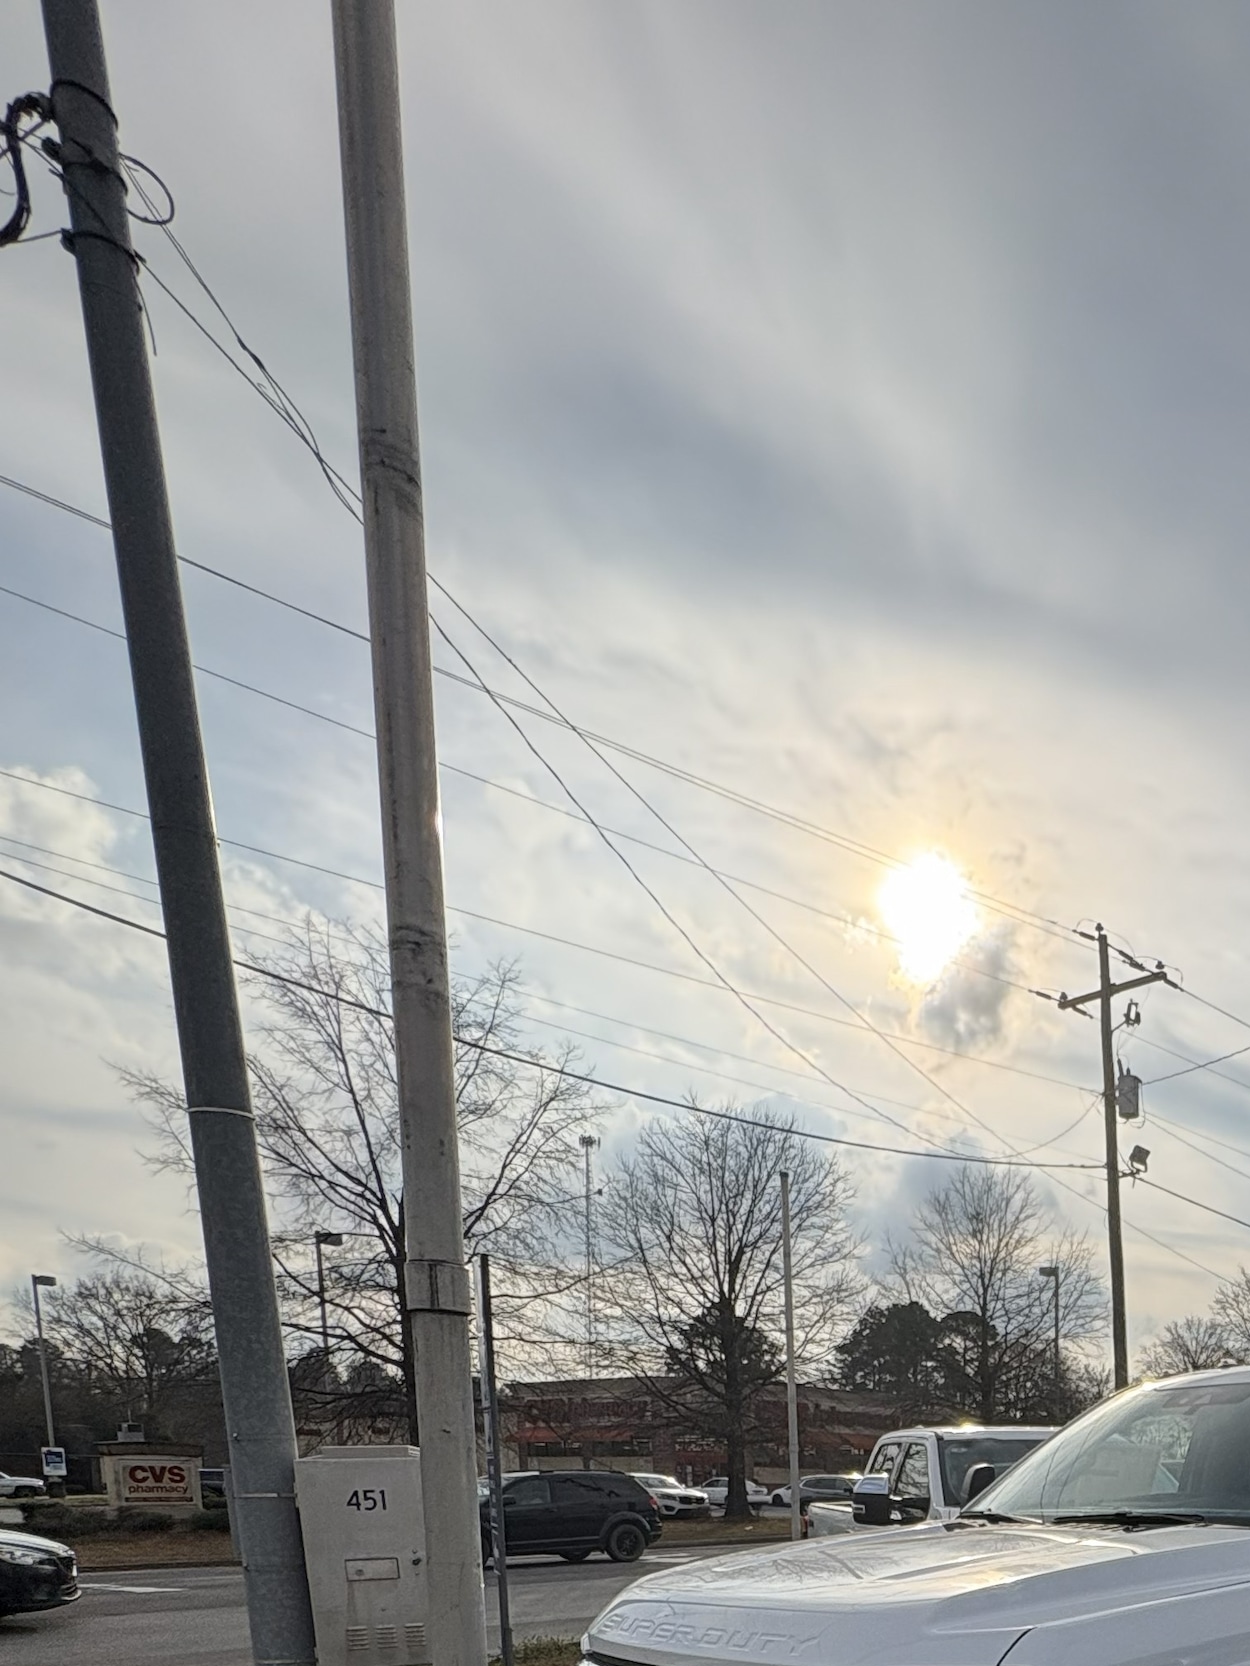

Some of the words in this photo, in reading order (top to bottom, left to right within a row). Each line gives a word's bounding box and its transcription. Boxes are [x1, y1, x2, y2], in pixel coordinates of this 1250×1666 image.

[129, 1465, 186, 1484] CVS
[128, 1485, 188, 1495] pharmacy
[346, 1489, 387, 1511] 451
[602, 1613, 696, 1645] SUPER
[698, 1626, 820, 1657] DUTY
